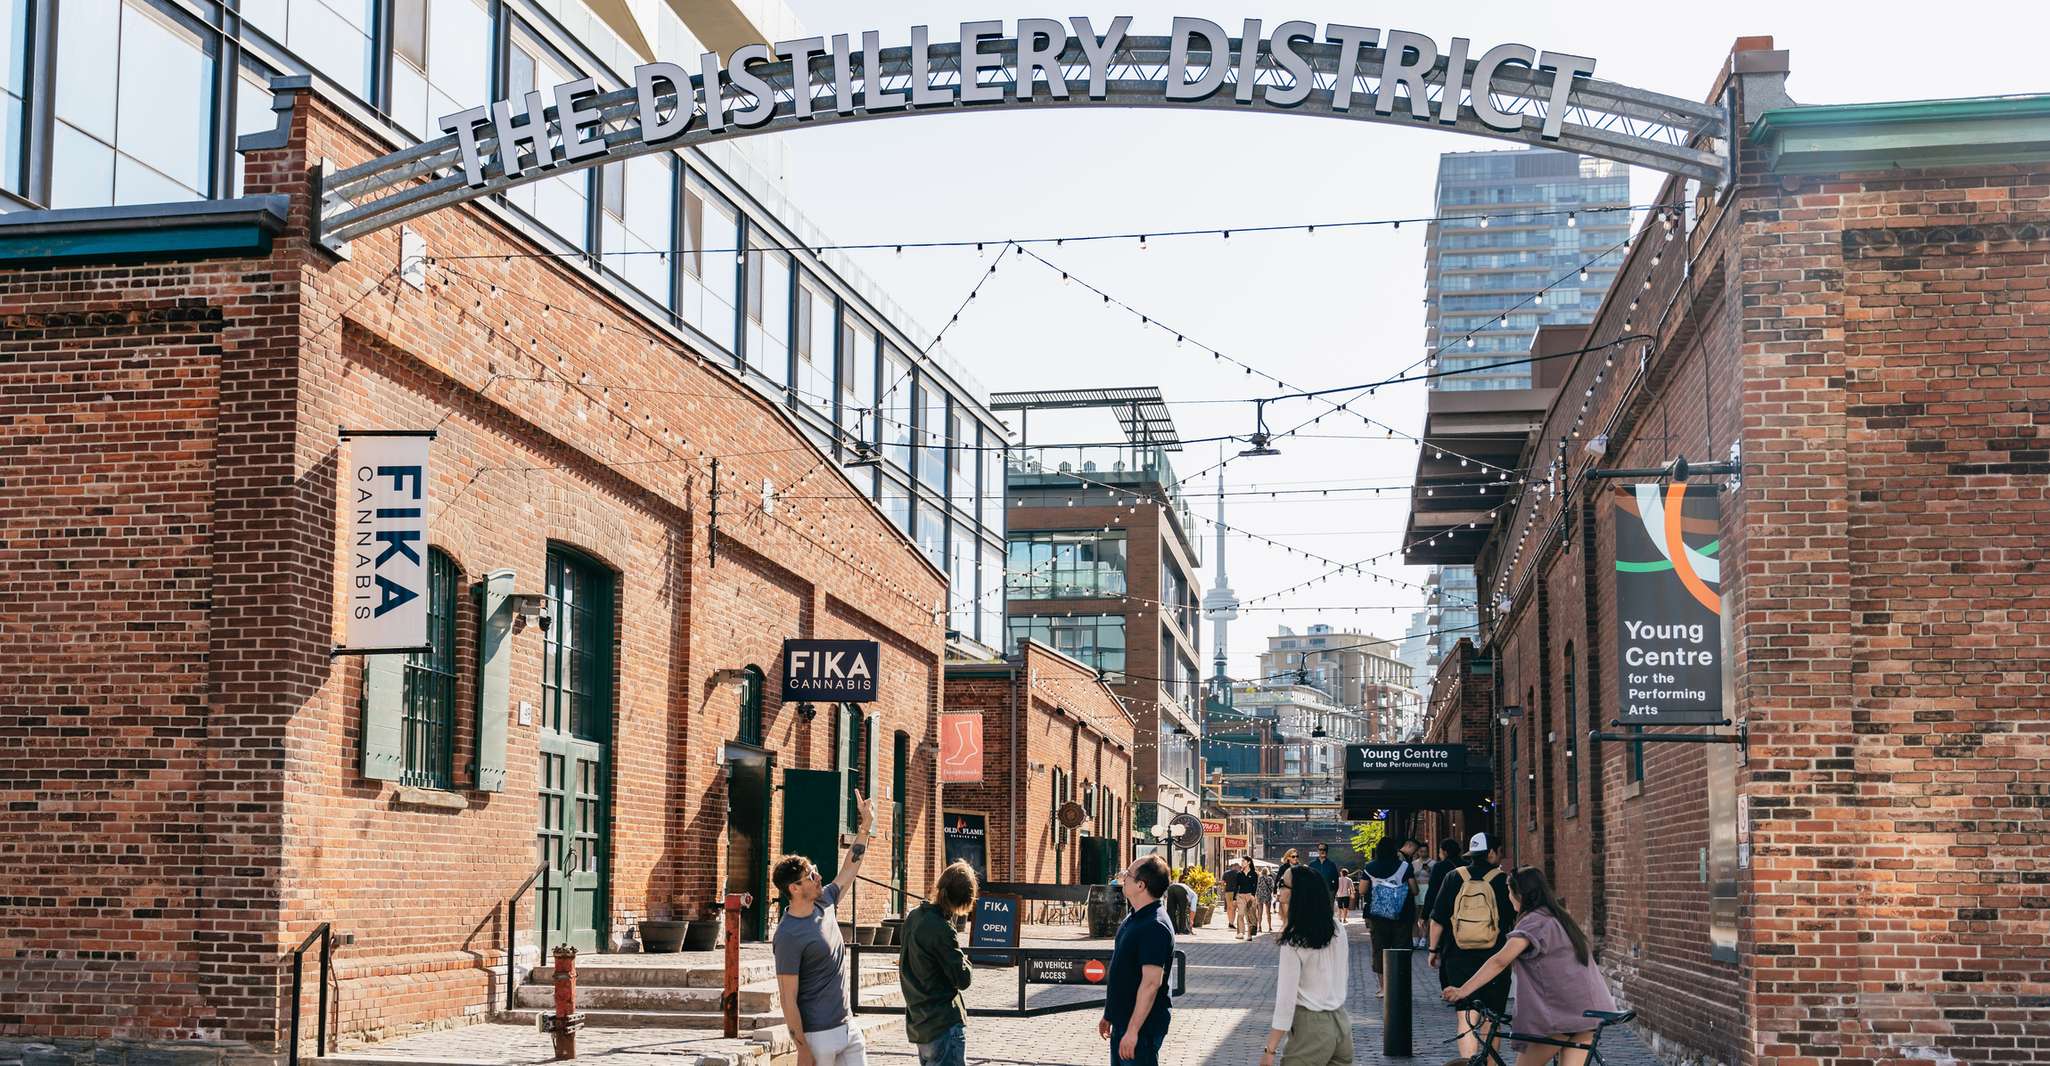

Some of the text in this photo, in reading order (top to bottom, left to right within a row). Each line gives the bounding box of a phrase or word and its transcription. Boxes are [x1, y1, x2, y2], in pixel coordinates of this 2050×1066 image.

[439, 15, 1597, 189] THE DISTILLERY DISTRICT
[354, 465, 374, 620] CANNABIS
[374, 465, 422, 619] FIKA
[1624, 620, 1704, 643] Young
[1625, 646, 1713, 666] Centre
[790, 651, 871, 678] FIKA
[1628, 673, 1675, 684] for the
[789, 679, 871, 690] CANNABIS
[1629, 688, 1706, 701] Performing
[1628, 704, 1659, 715] Arts
[1360, 748, 1448, 760] Young Centre
[1389, 761, 1430, 769] Performing
[944, 826, 984, 836] OLD FLAME
[984, 901, 1009, 912] FIKA
[982, 923, 1007, 933] OPEN
[1033, 961, 1073, 970] NO VEHICLE
[1040, 971, 1066, 980] ACCESS
